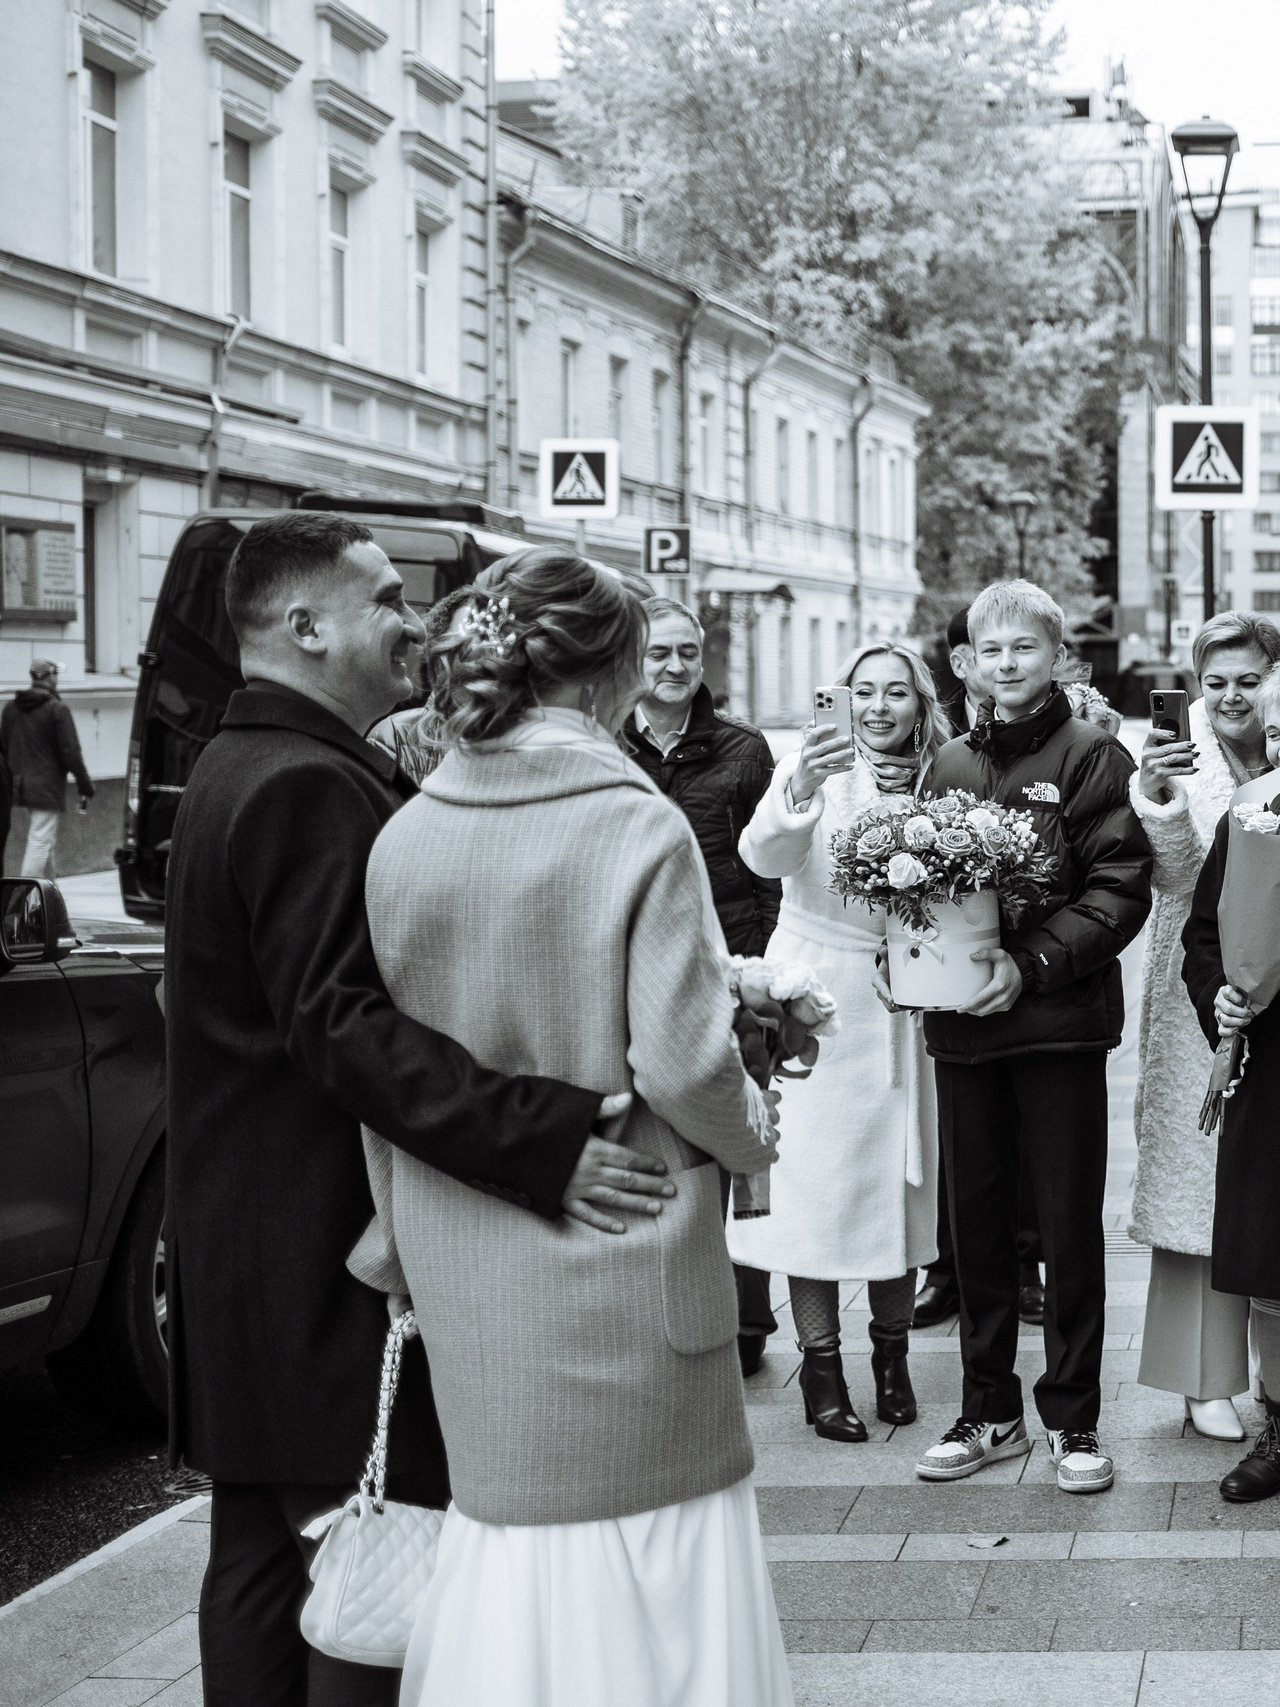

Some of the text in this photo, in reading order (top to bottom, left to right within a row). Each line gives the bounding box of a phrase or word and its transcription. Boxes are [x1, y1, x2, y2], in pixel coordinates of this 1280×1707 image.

[650, 530, 681, 573] P
[1022, 786, 1046, 795] NORTH
[1039, 953, 1049, 966] 700
